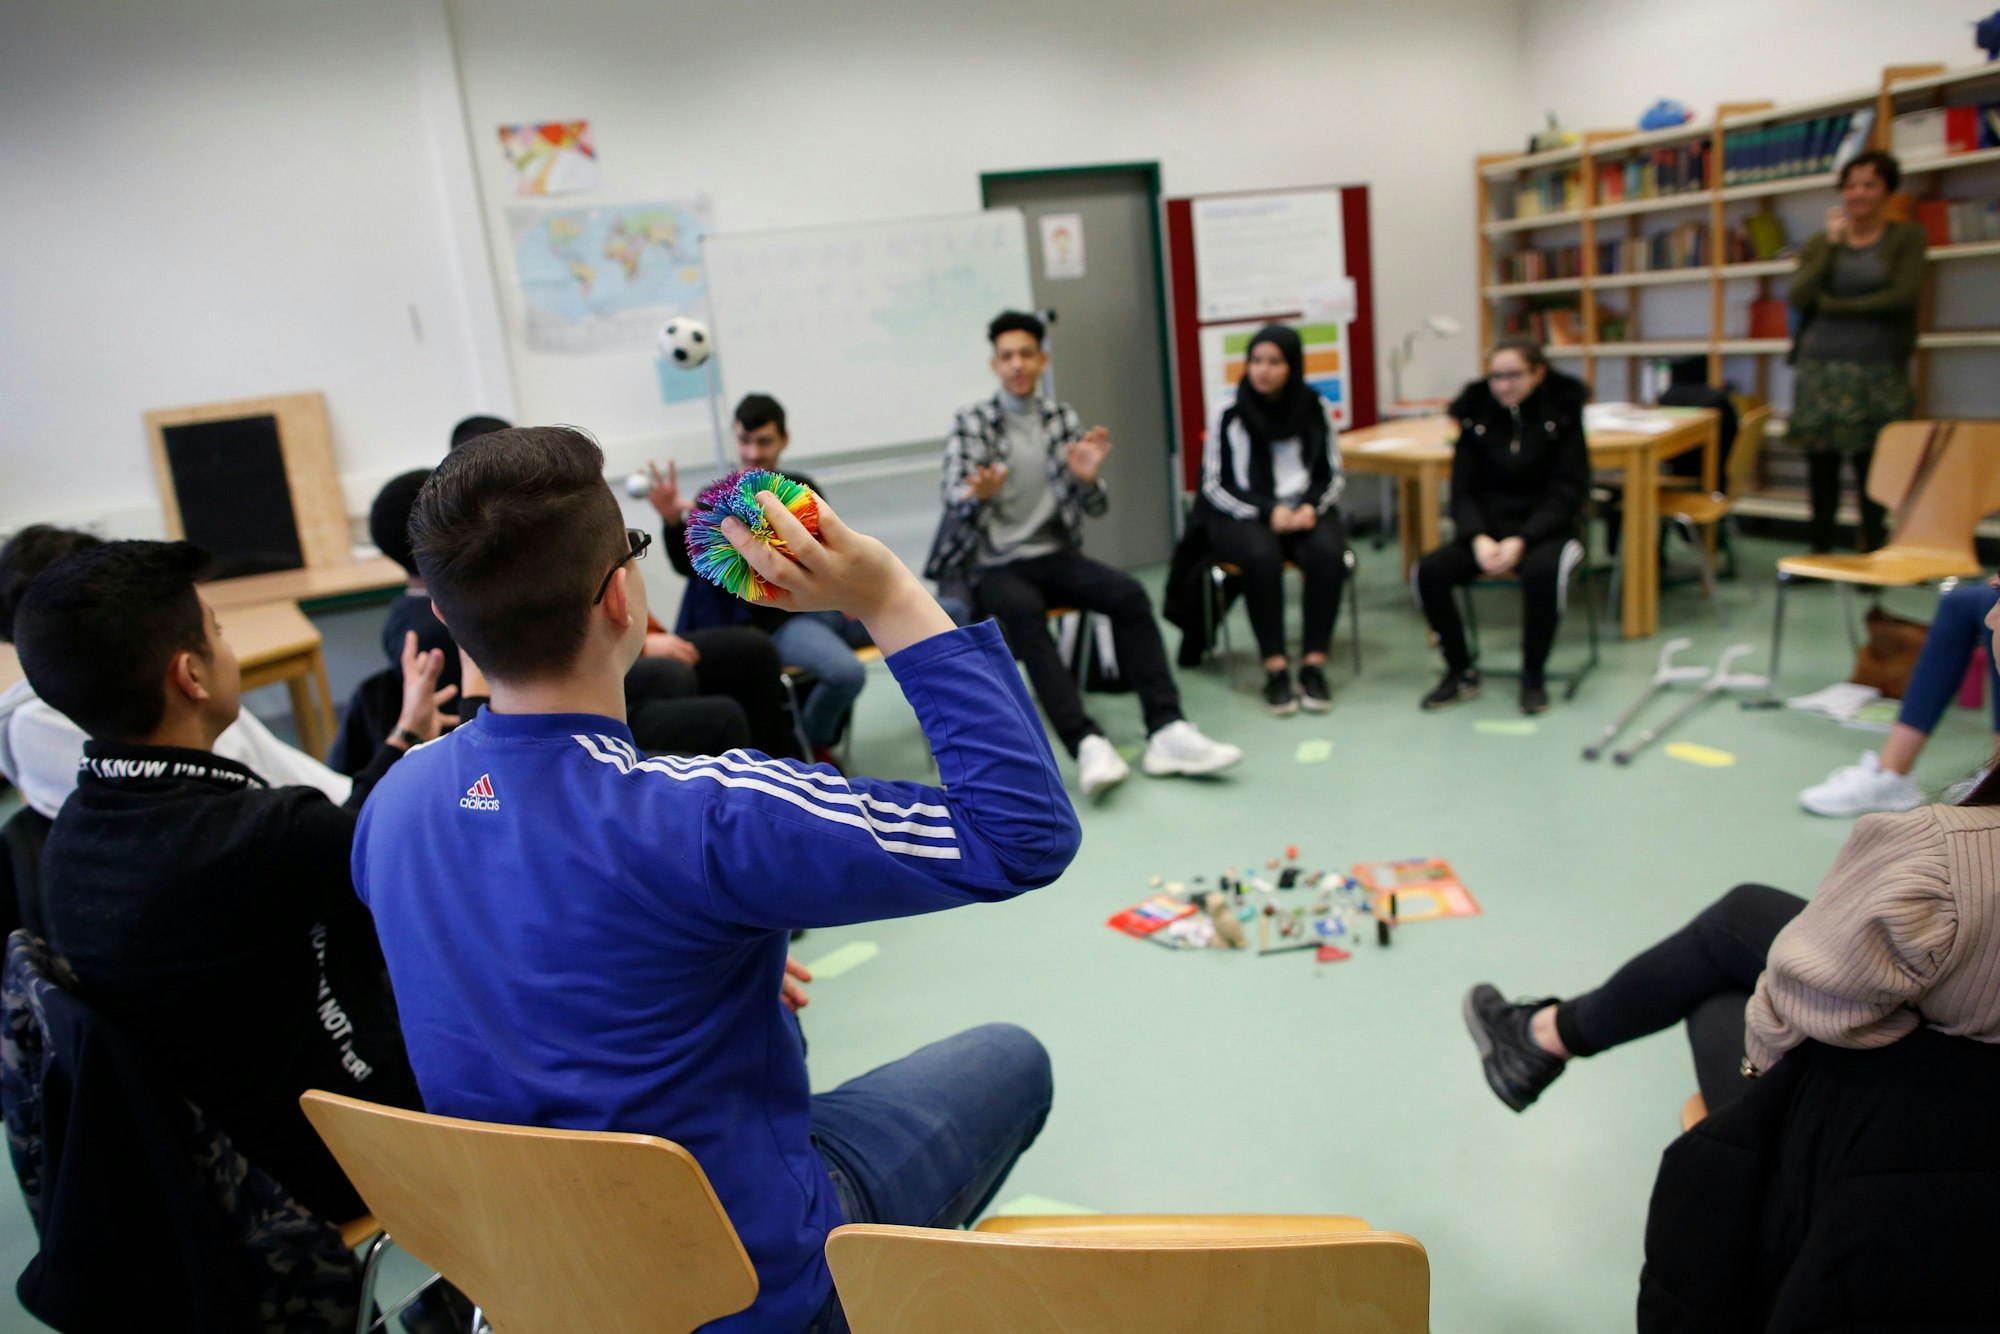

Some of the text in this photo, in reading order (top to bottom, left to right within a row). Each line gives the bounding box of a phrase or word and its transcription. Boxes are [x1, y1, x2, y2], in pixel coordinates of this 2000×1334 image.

[101, 757, 169, 779] KNOW
[459, 796, 500, 811] adidas
[317, 997, 354, 1041] NOT
